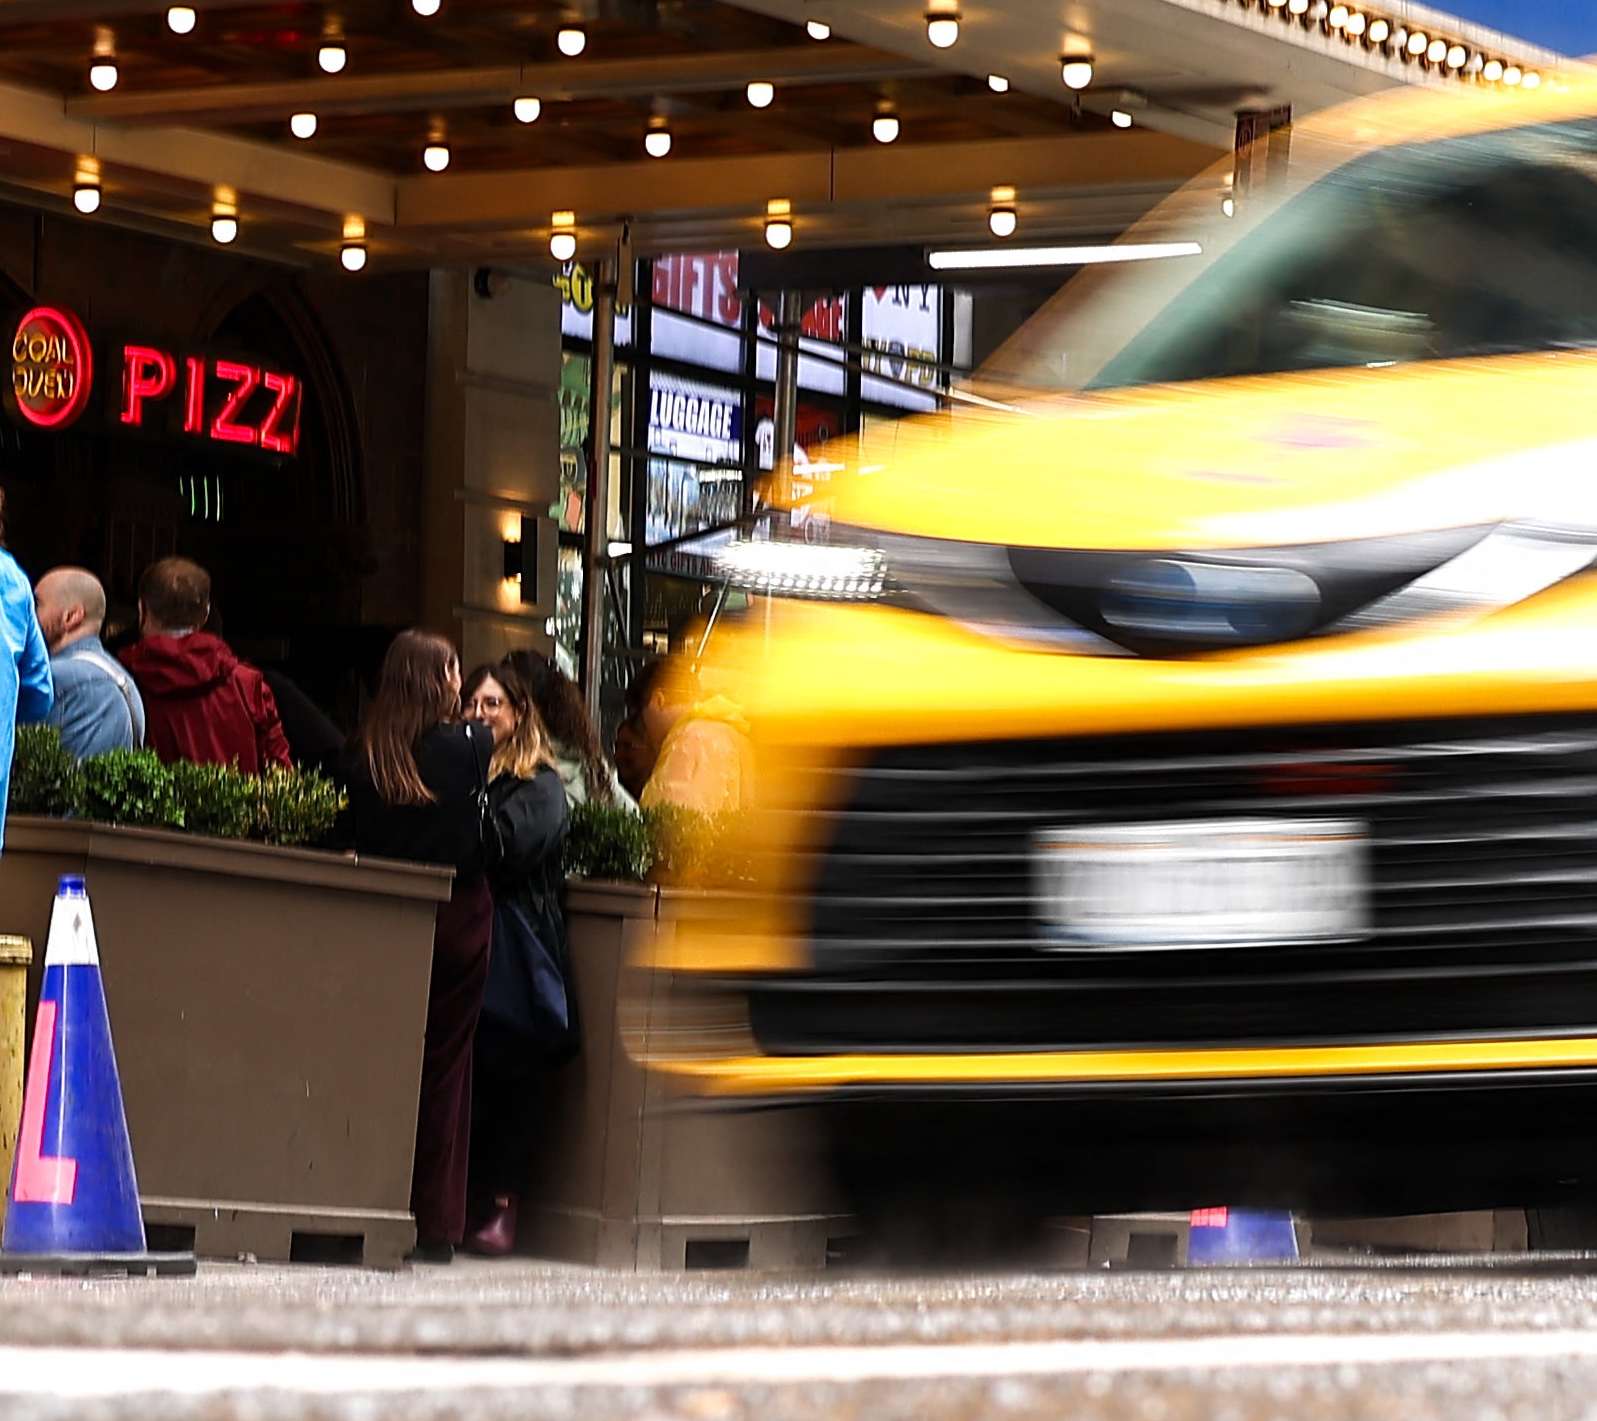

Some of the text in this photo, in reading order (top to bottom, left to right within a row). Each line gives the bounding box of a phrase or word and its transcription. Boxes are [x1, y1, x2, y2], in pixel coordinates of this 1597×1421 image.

[652, 254, 740, 325] GIFTS
[12, 332, 74, 363] COAL
[120, 345, 296, 455] PIZZ
[649, 390, 733, 440] LUGGAGE
[14, 1001, 78, 1205] L
